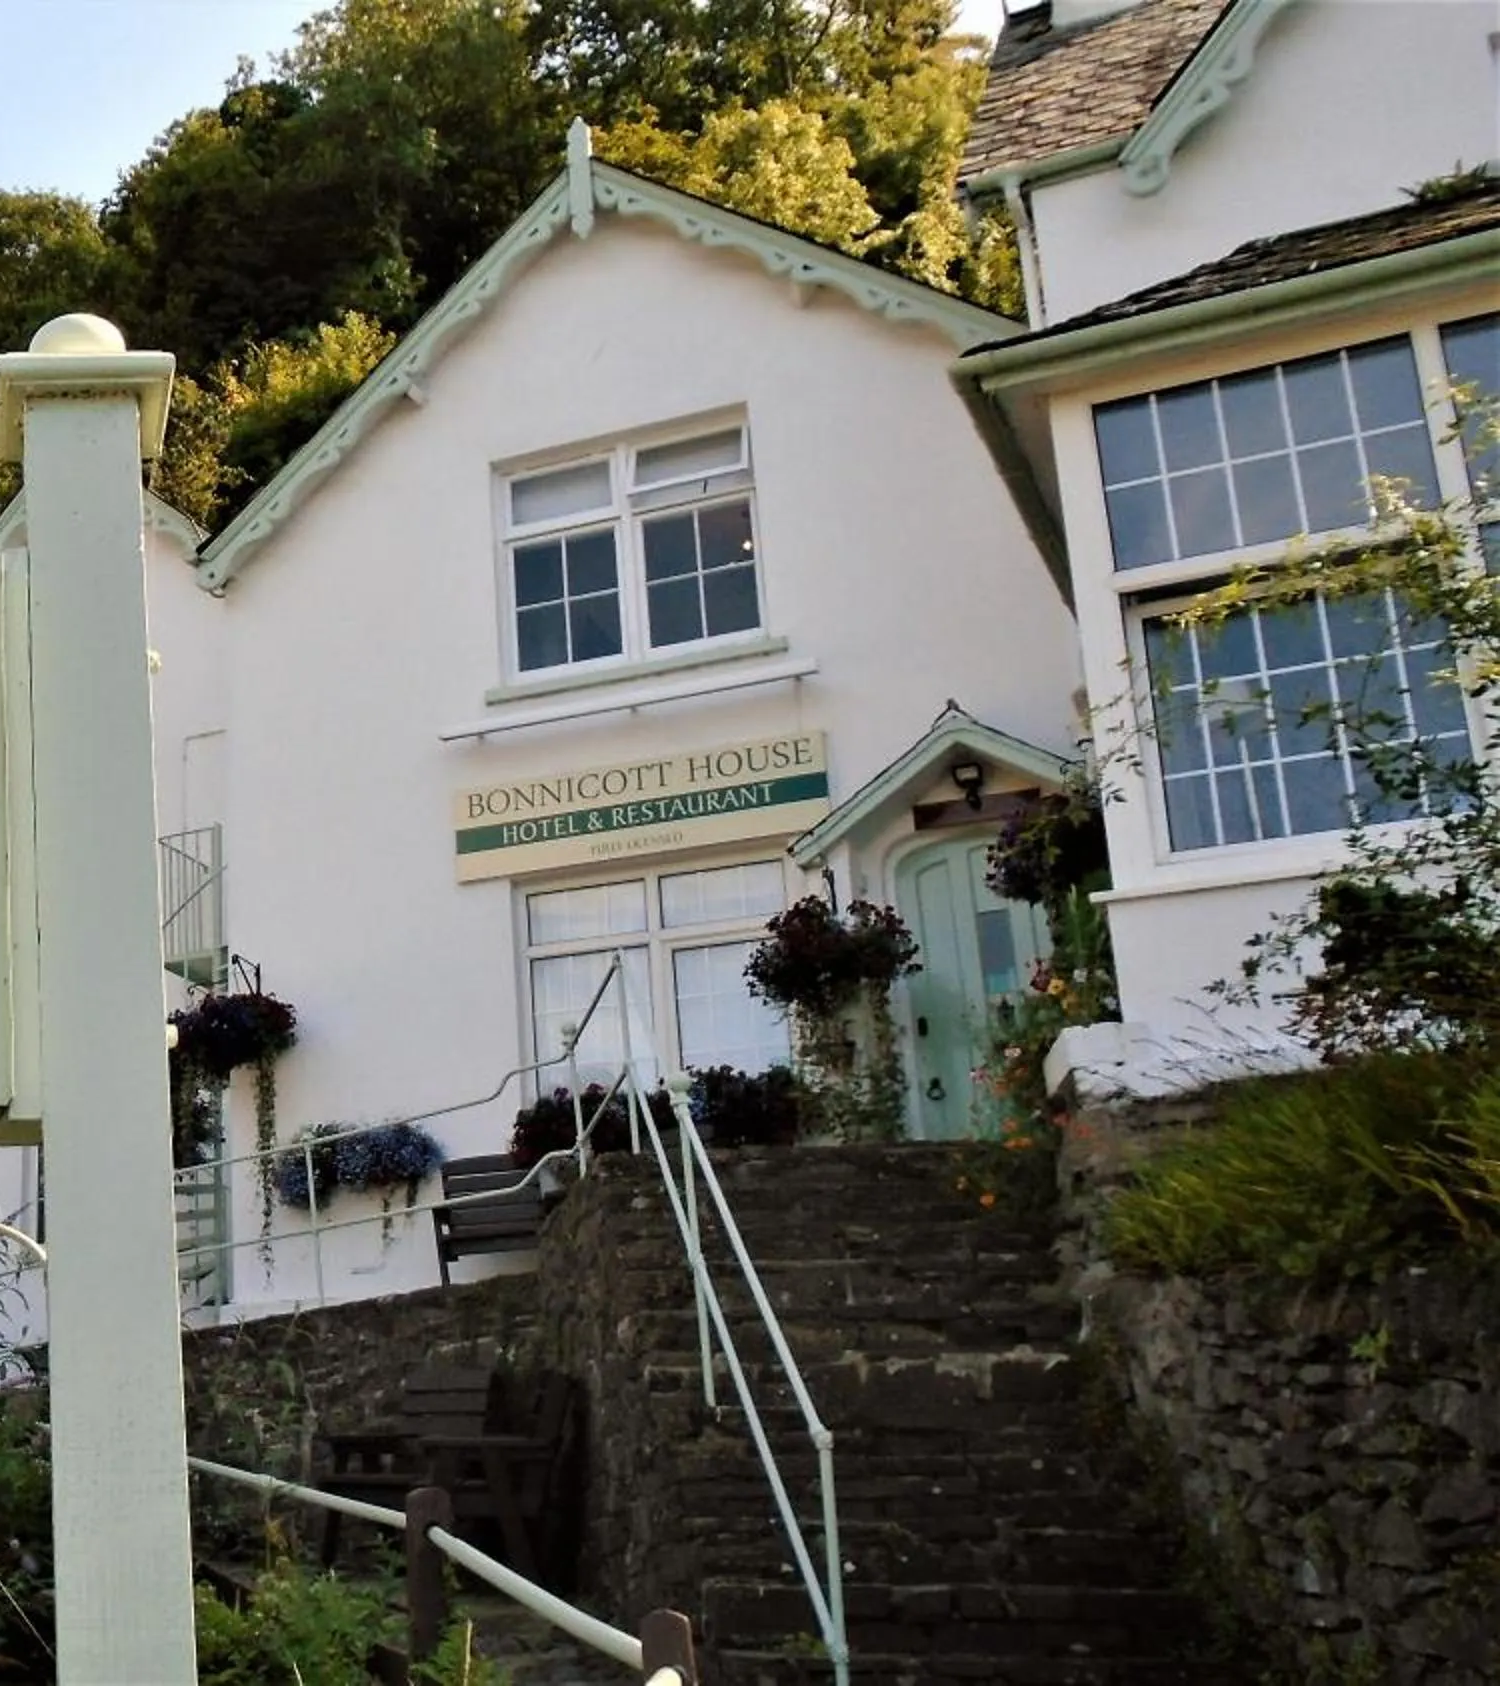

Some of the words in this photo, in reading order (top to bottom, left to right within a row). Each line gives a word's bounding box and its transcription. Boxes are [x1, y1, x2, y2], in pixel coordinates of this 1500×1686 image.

[467, 761, 673, 819] BONNICOTT
[688, 737, 813, 782] HOUSE
[502, 814, 579, 845] HOTEL
[587, 809, 605, 831] &
[612, 784, 775, 827] RESTAURANT
